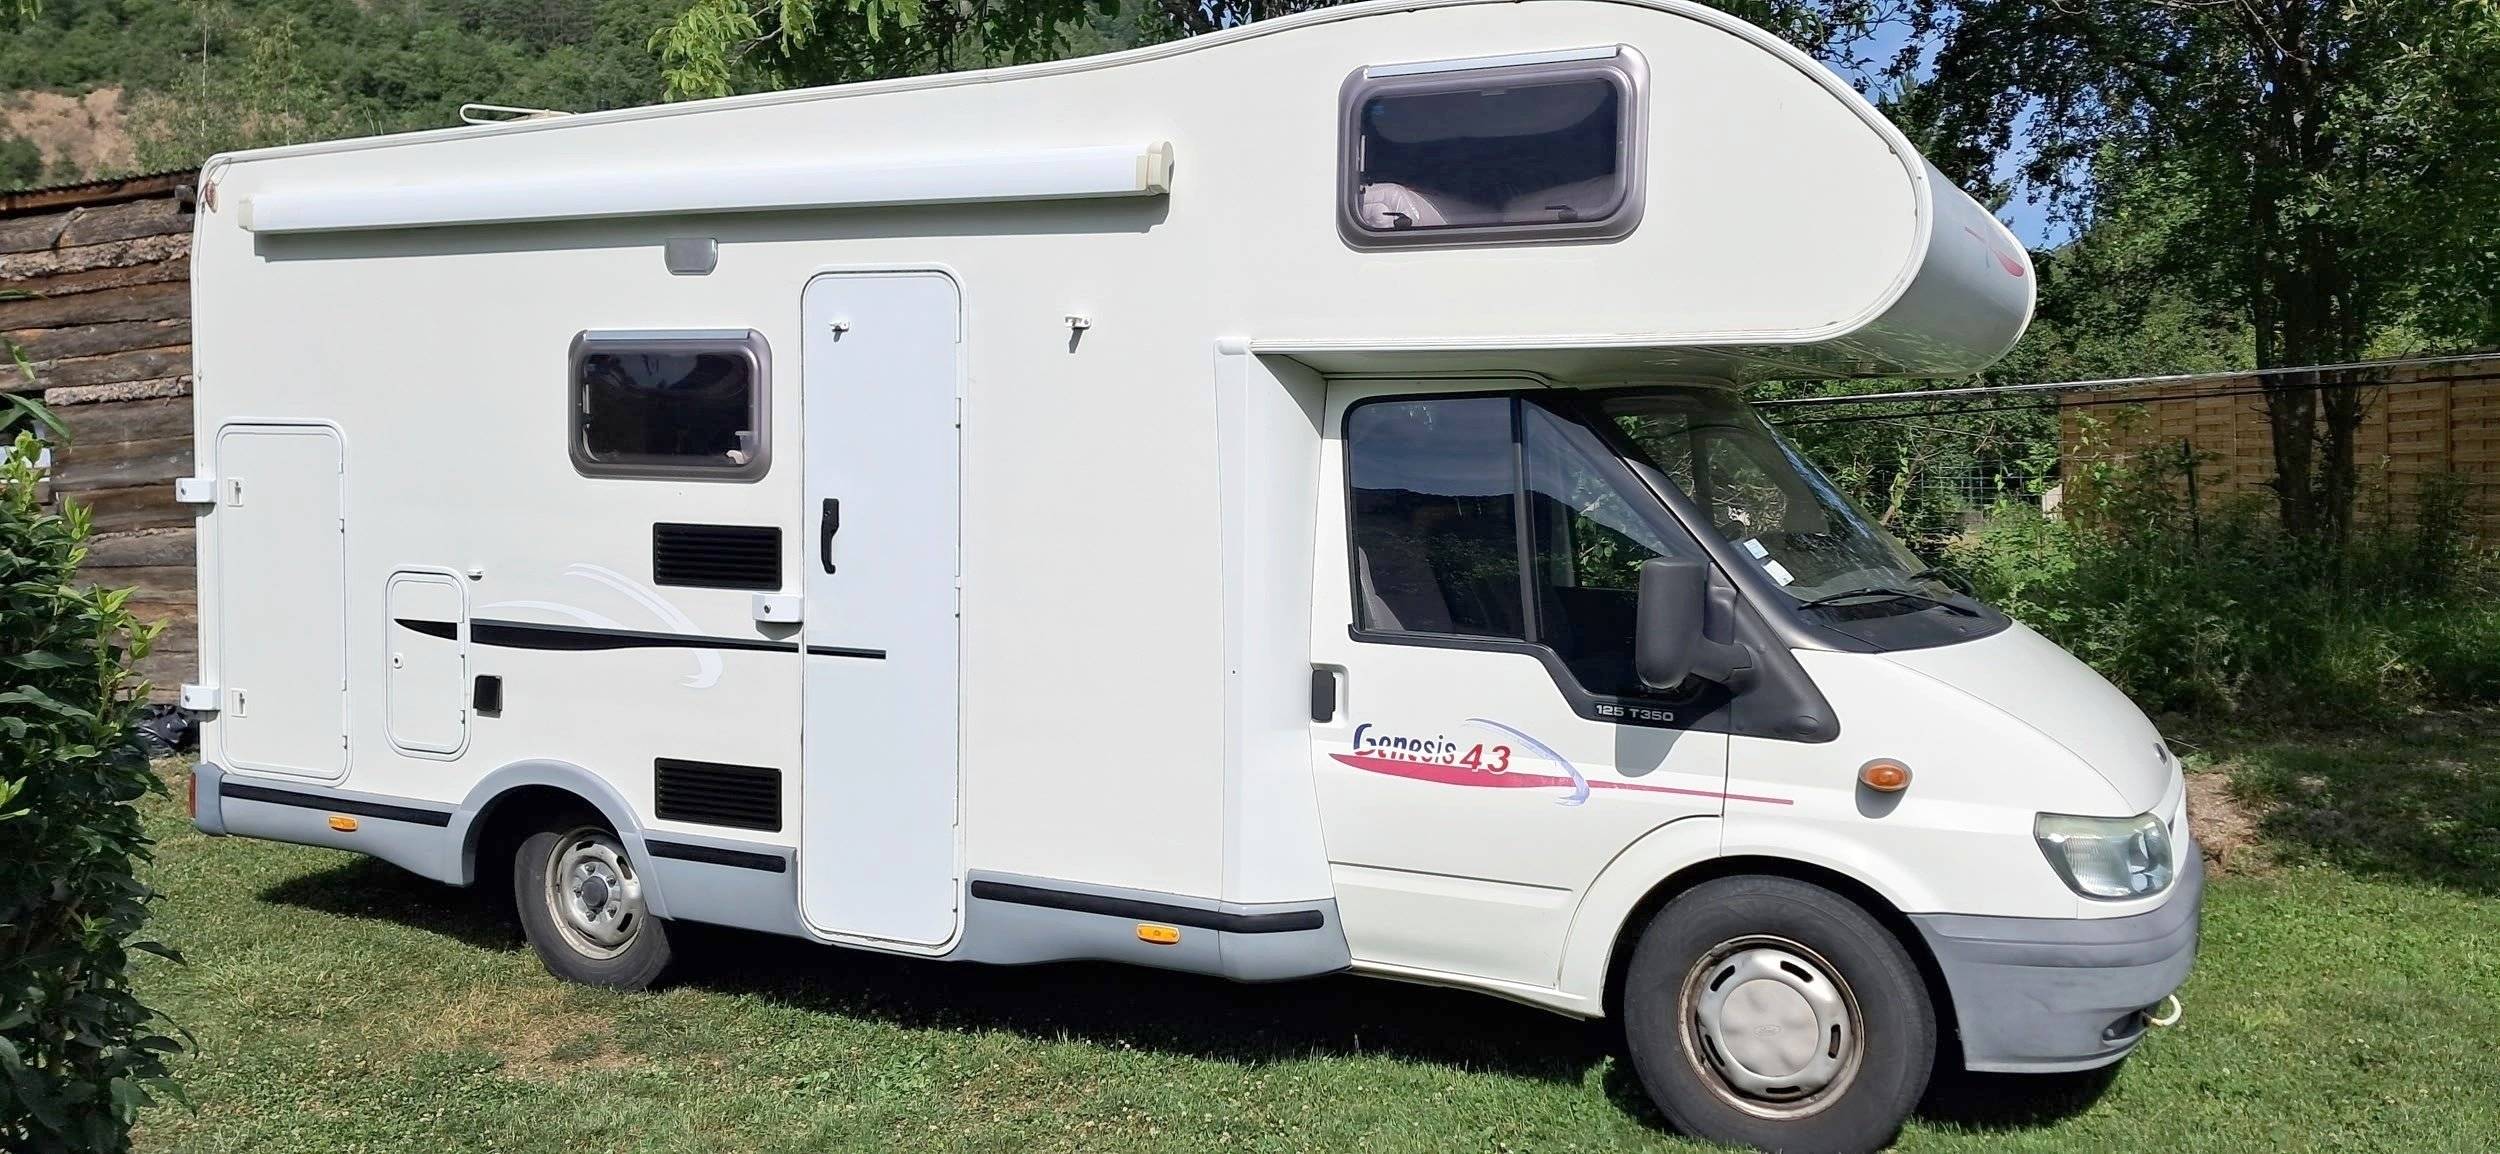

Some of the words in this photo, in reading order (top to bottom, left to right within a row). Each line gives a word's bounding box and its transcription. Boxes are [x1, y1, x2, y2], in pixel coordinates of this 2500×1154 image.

[1596, 704, 1625, 717] 125
[1629, 708, 1674, 722] T350
[1353, 723, 1457, 765] Genesis
[1459, 743, 1512, 773] 43
